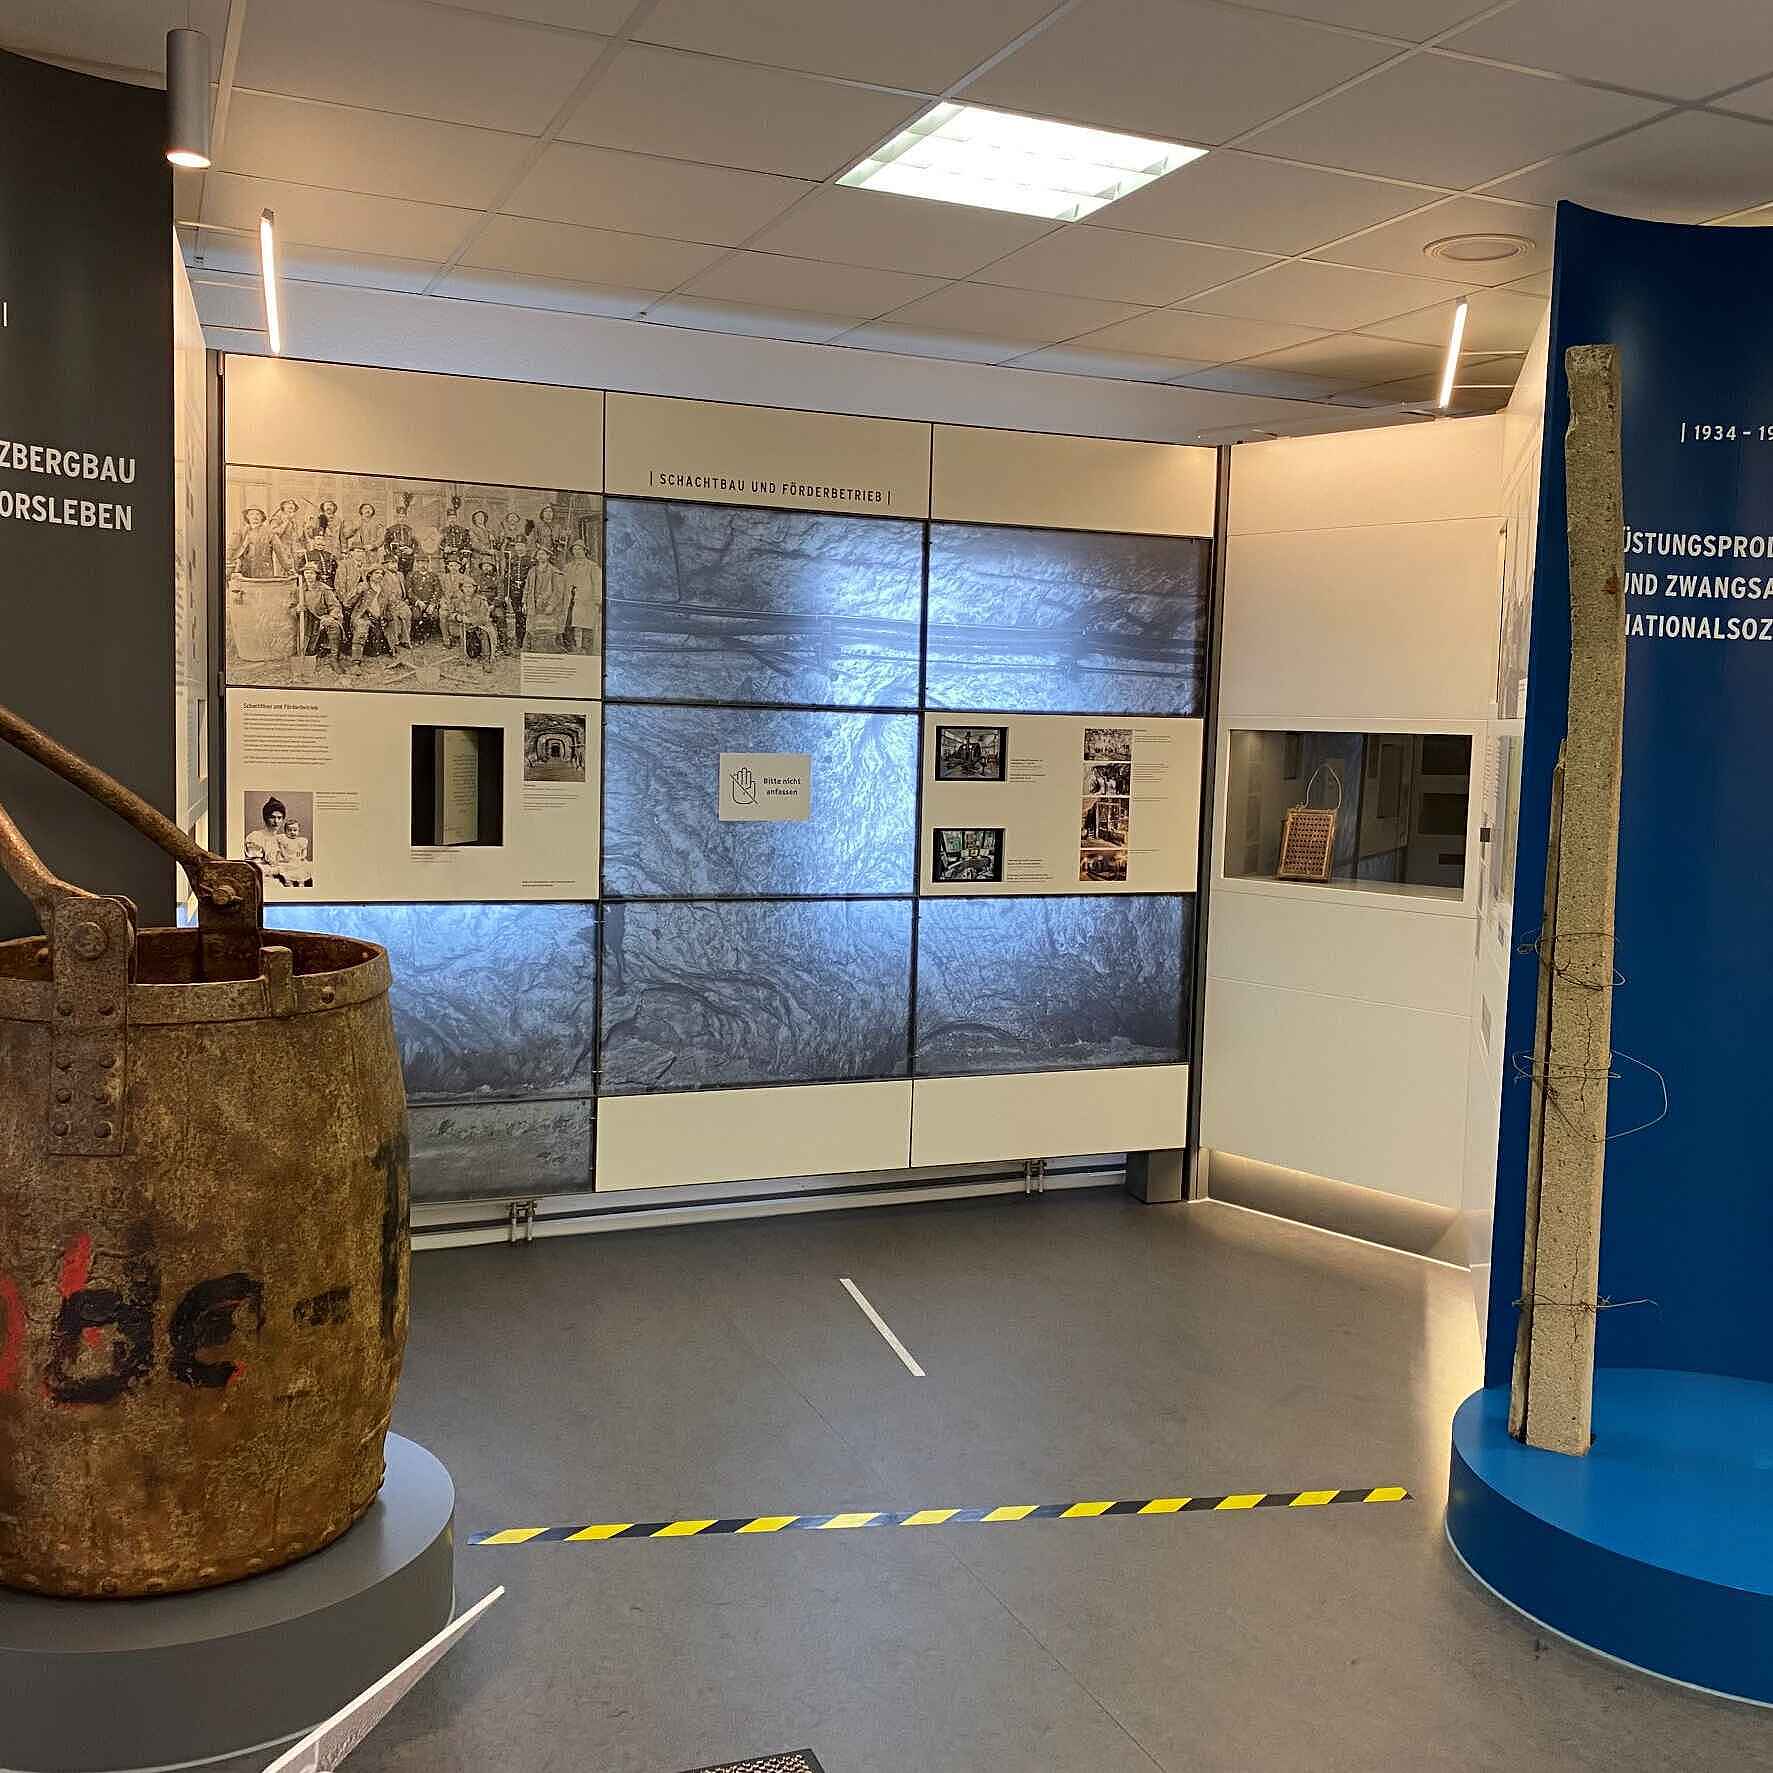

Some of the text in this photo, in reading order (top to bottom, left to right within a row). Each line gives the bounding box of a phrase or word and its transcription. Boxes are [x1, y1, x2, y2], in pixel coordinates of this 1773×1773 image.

[1694, 425, 1736, 441] 1934
[0, 439, 136, 484] ZBERGBAU
[659, 472, 882, 503] SCHACHTBAU UND FÖRDERBETRIEB
[0, 490, 132, 531] ORSLEBEN
[766, 788, 798, 796] anfassen
[782, 777, 801, 785] nicht
